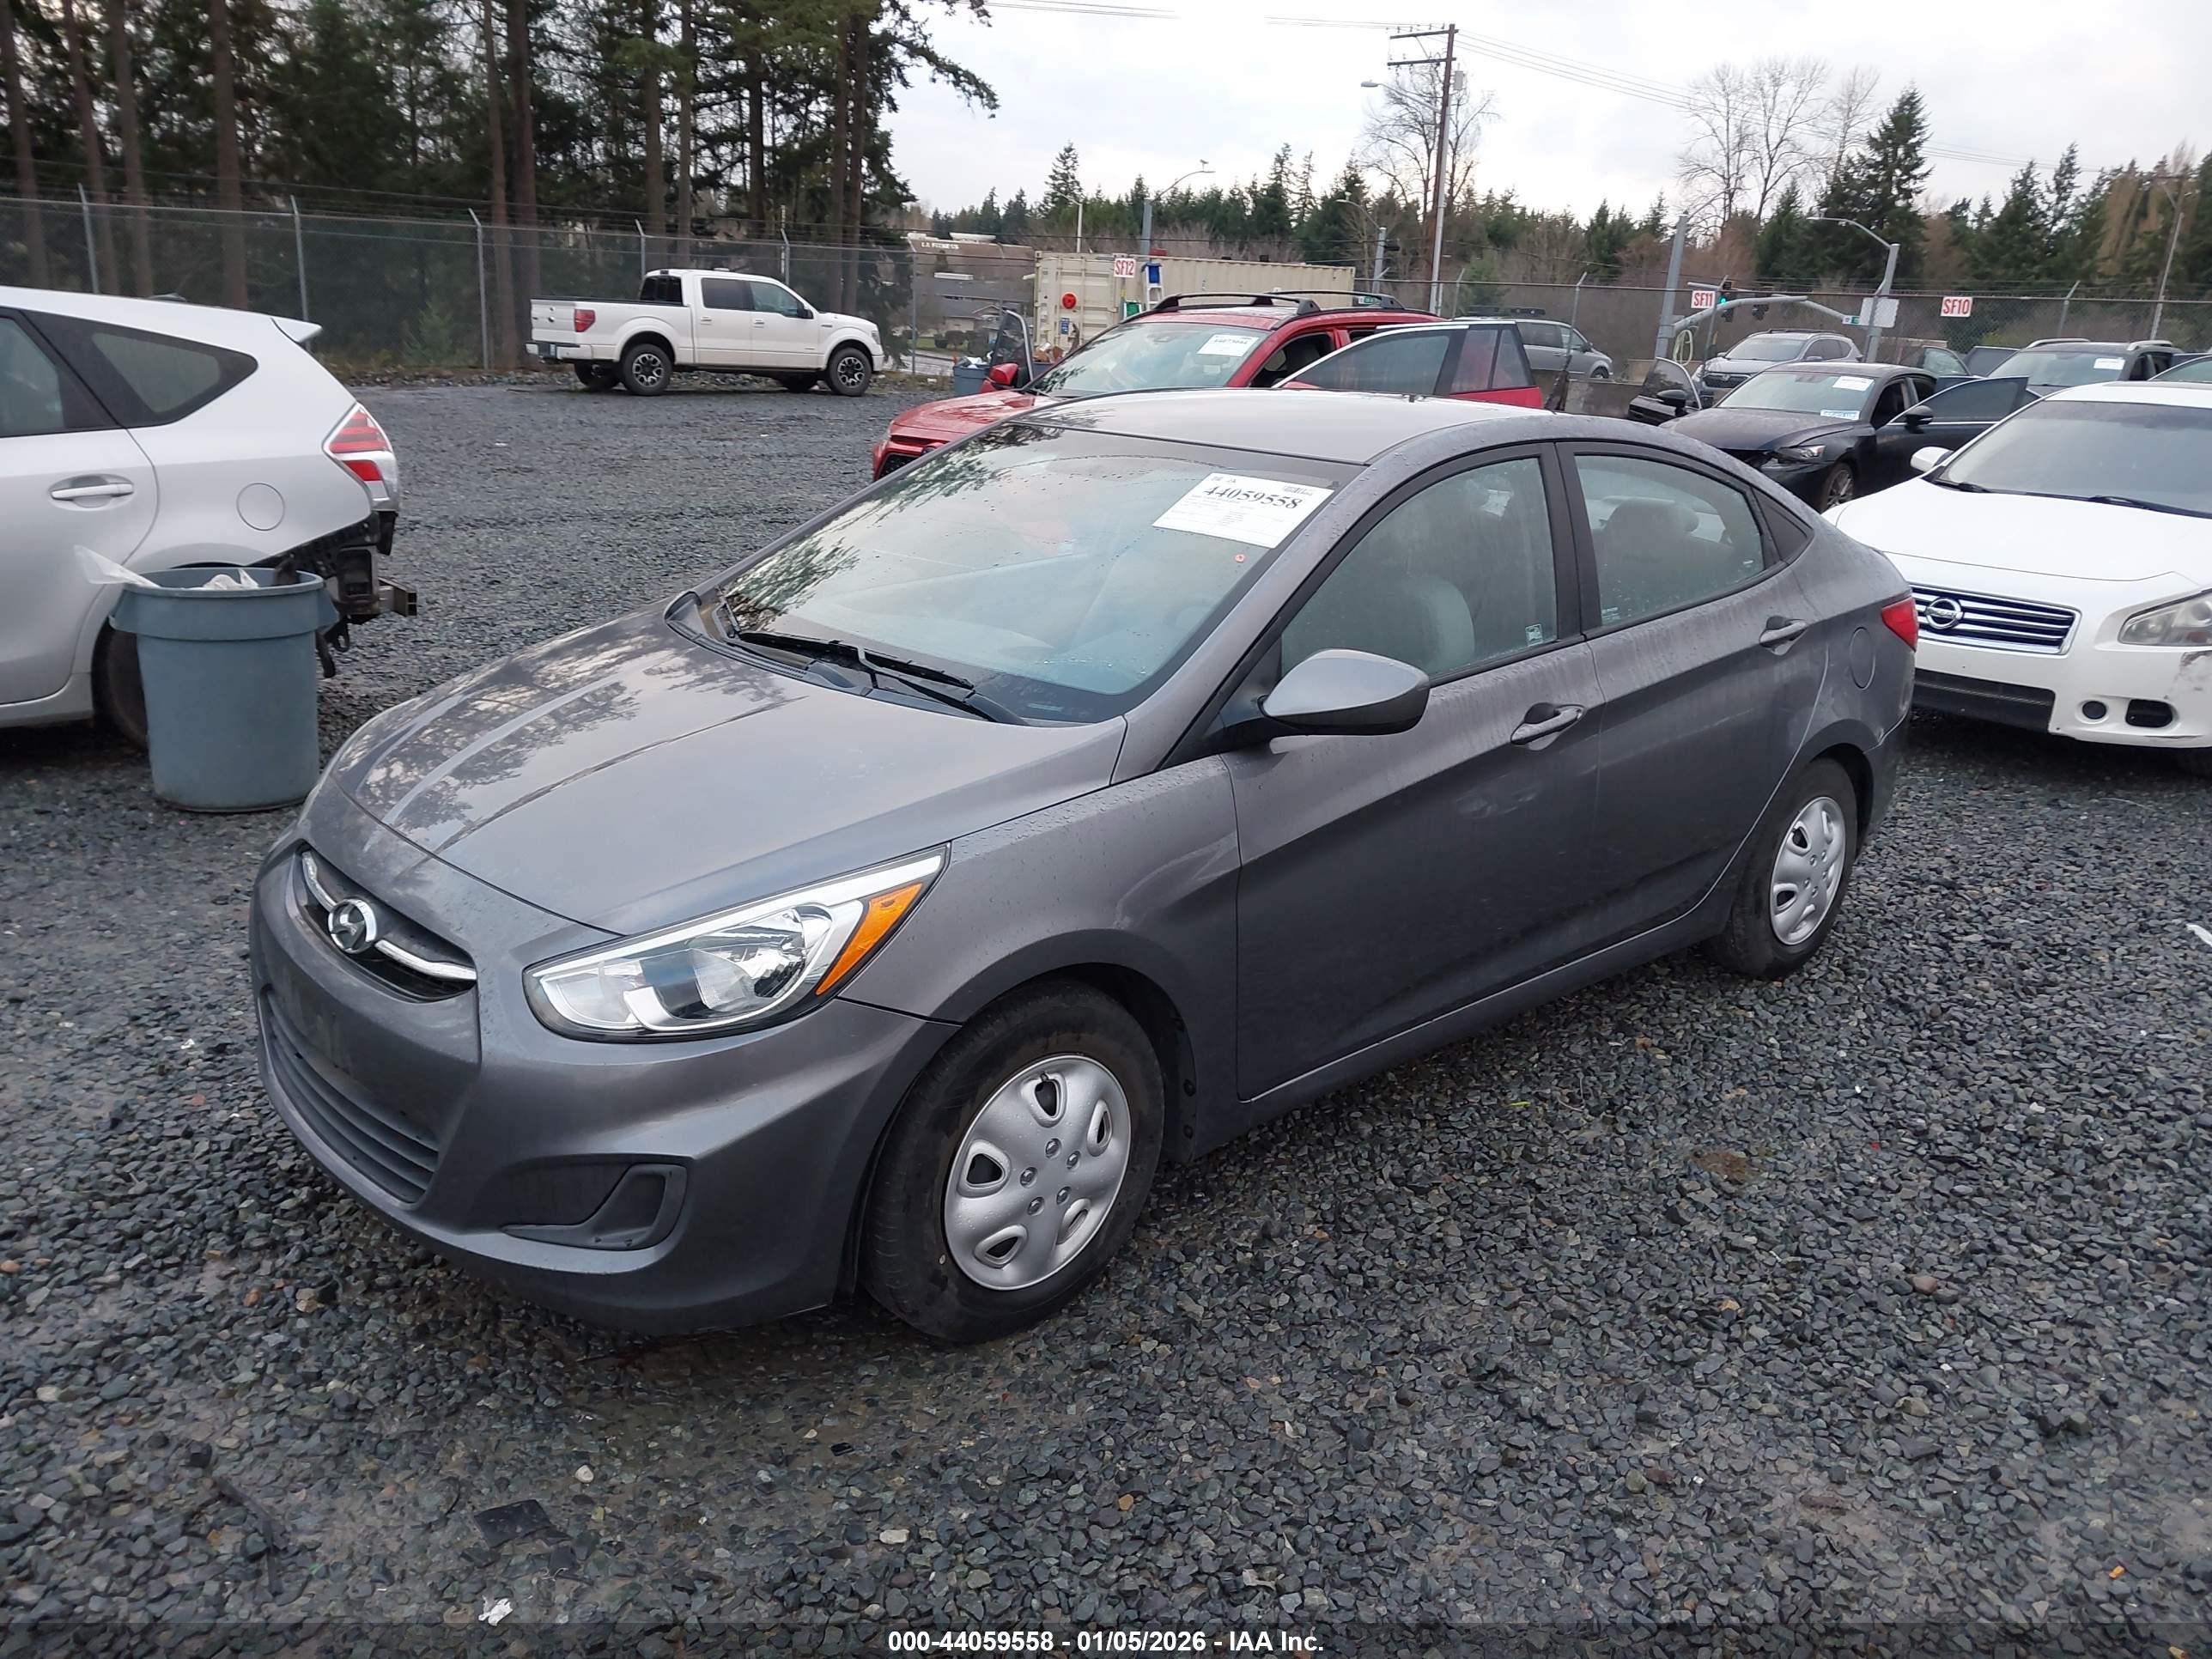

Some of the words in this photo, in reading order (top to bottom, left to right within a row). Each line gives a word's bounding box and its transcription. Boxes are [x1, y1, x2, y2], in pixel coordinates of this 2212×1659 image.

[1115, 259, 1134, 276] SF12
[1693, 292, 1714, 307] SF11
[1943, 298, 1971, 315] SF10
[1204, 485, 1304, 509] 44059558
